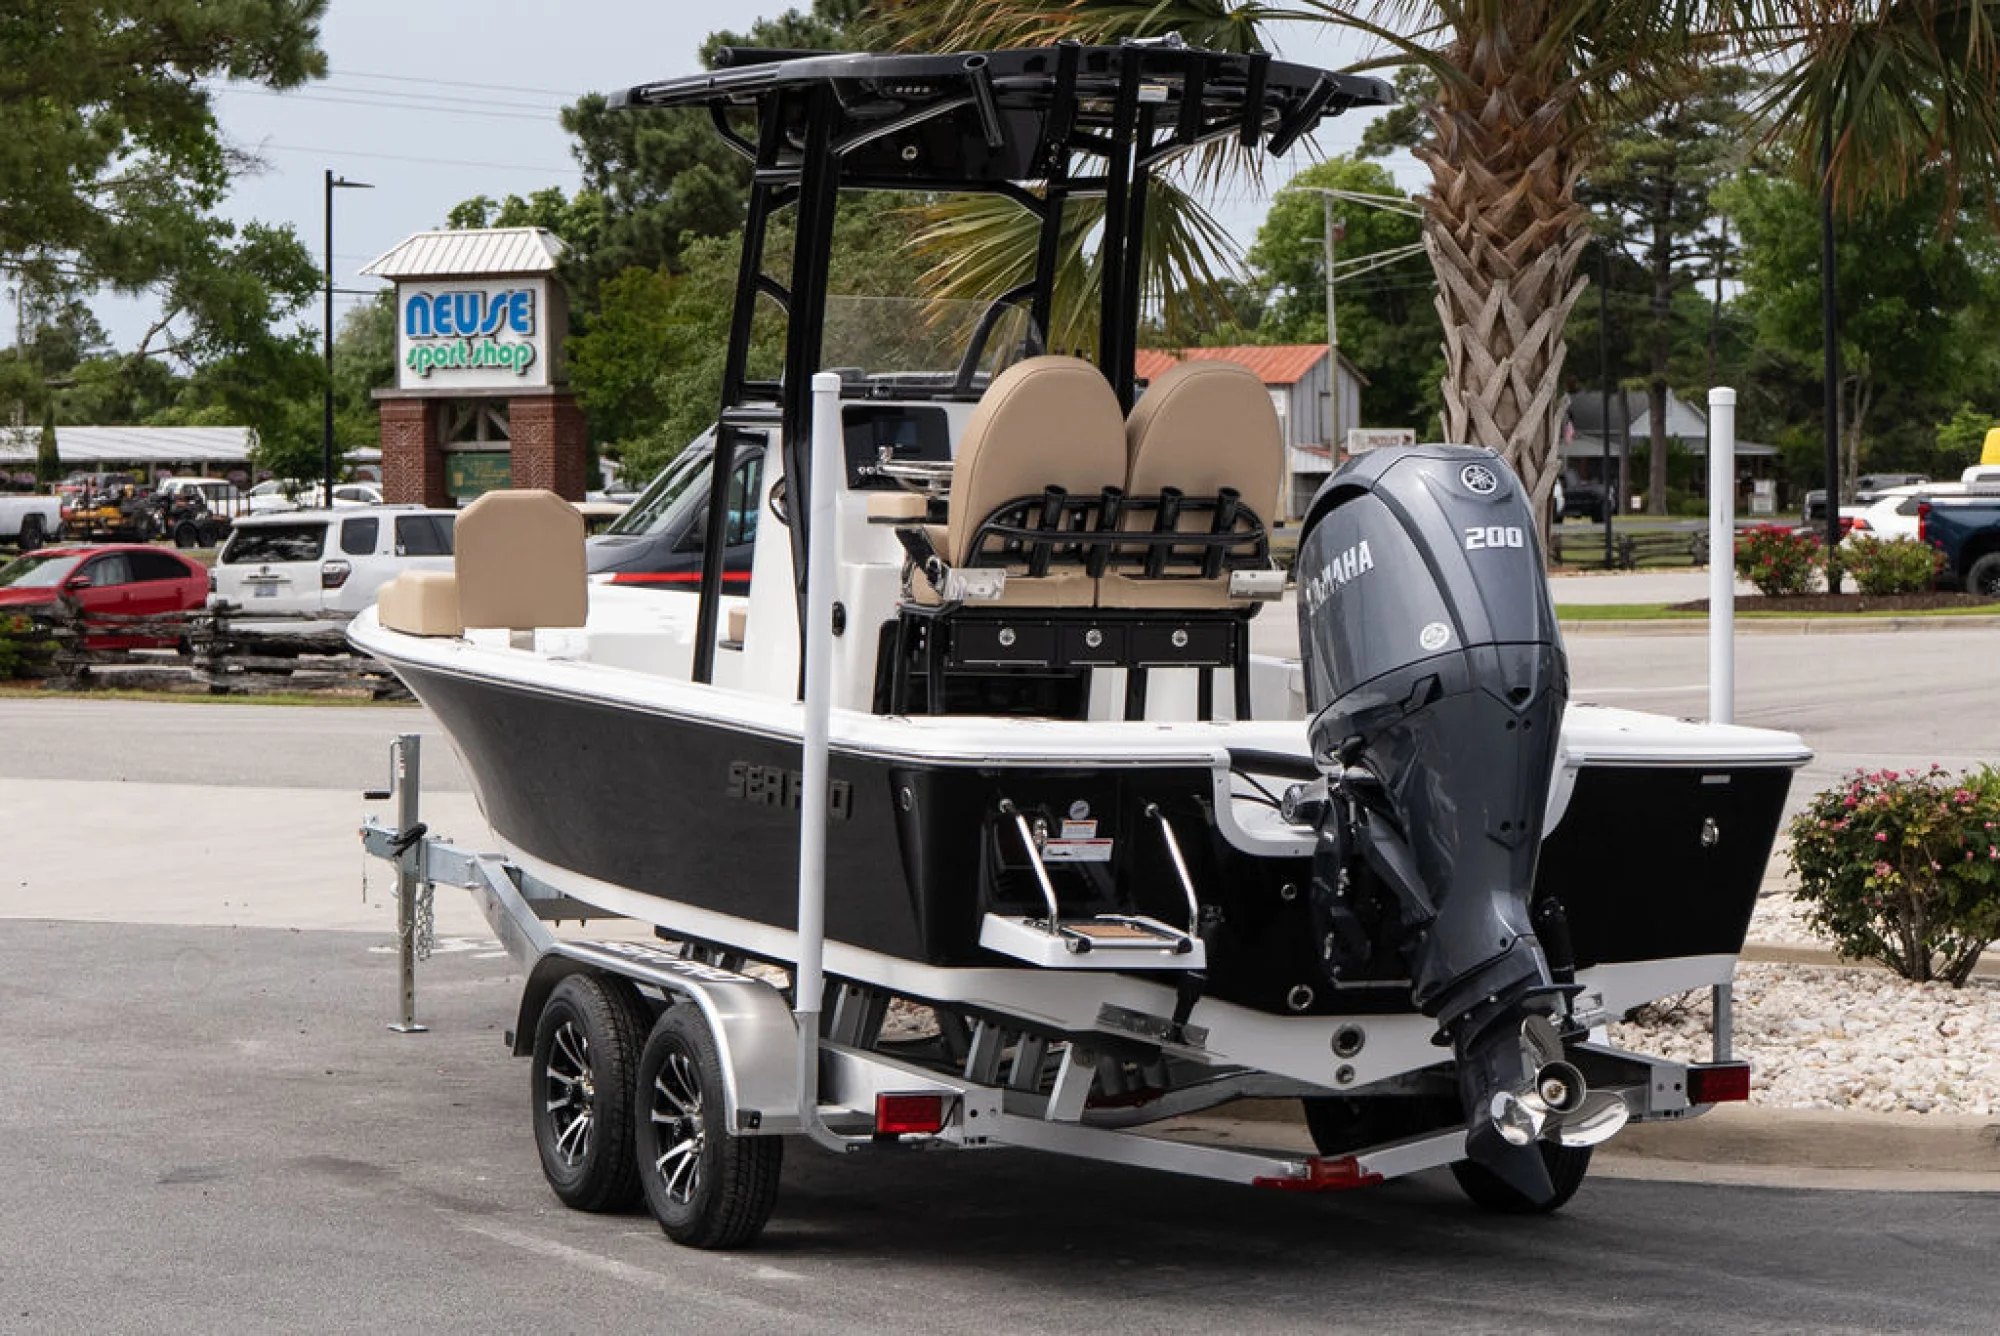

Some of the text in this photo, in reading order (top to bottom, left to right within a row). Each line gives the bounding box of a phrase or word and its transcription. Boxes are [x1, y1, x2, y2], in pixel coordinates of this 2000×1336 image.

[406, 291, 530, 336] NEUSE
[406, 339, 530, 374] sport shop
[1464, 526, 1525, 550] 200
[1306, 540, 1374, 616] YAMAHA
[726, 761, 783, 806] SEA
